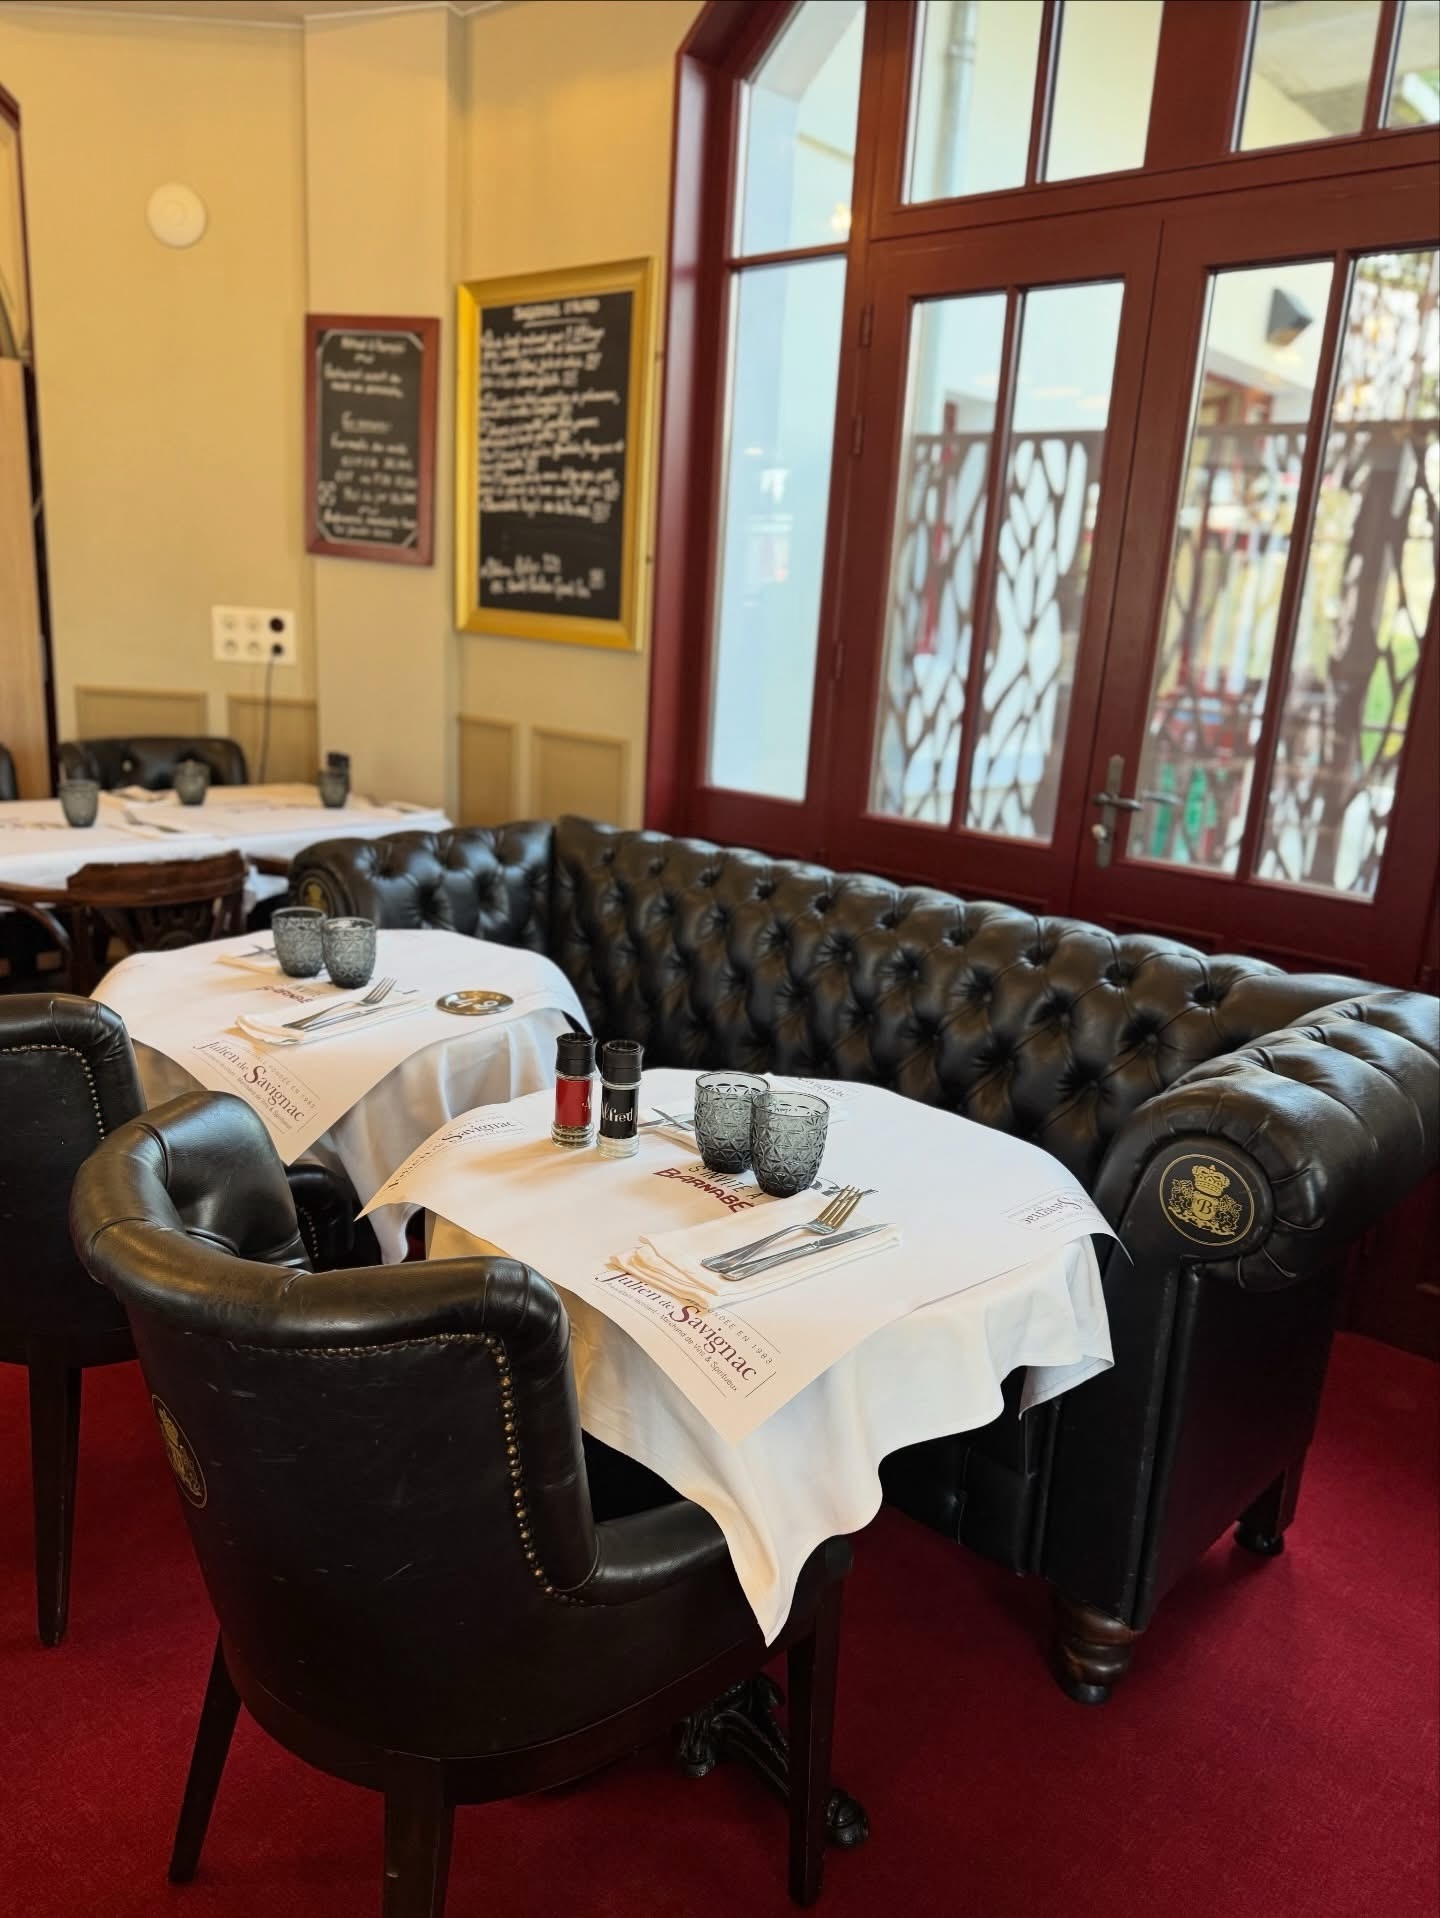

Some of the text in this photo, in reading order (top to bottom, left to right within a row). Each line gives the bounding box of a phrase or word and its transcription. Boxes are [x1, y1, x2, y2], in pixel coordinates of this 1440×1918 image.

[243, 1065, 305, 1122] Savignac
[594, 1271, 662, 1301] Julien
[668, 1305, 757, 1381] Savignac
